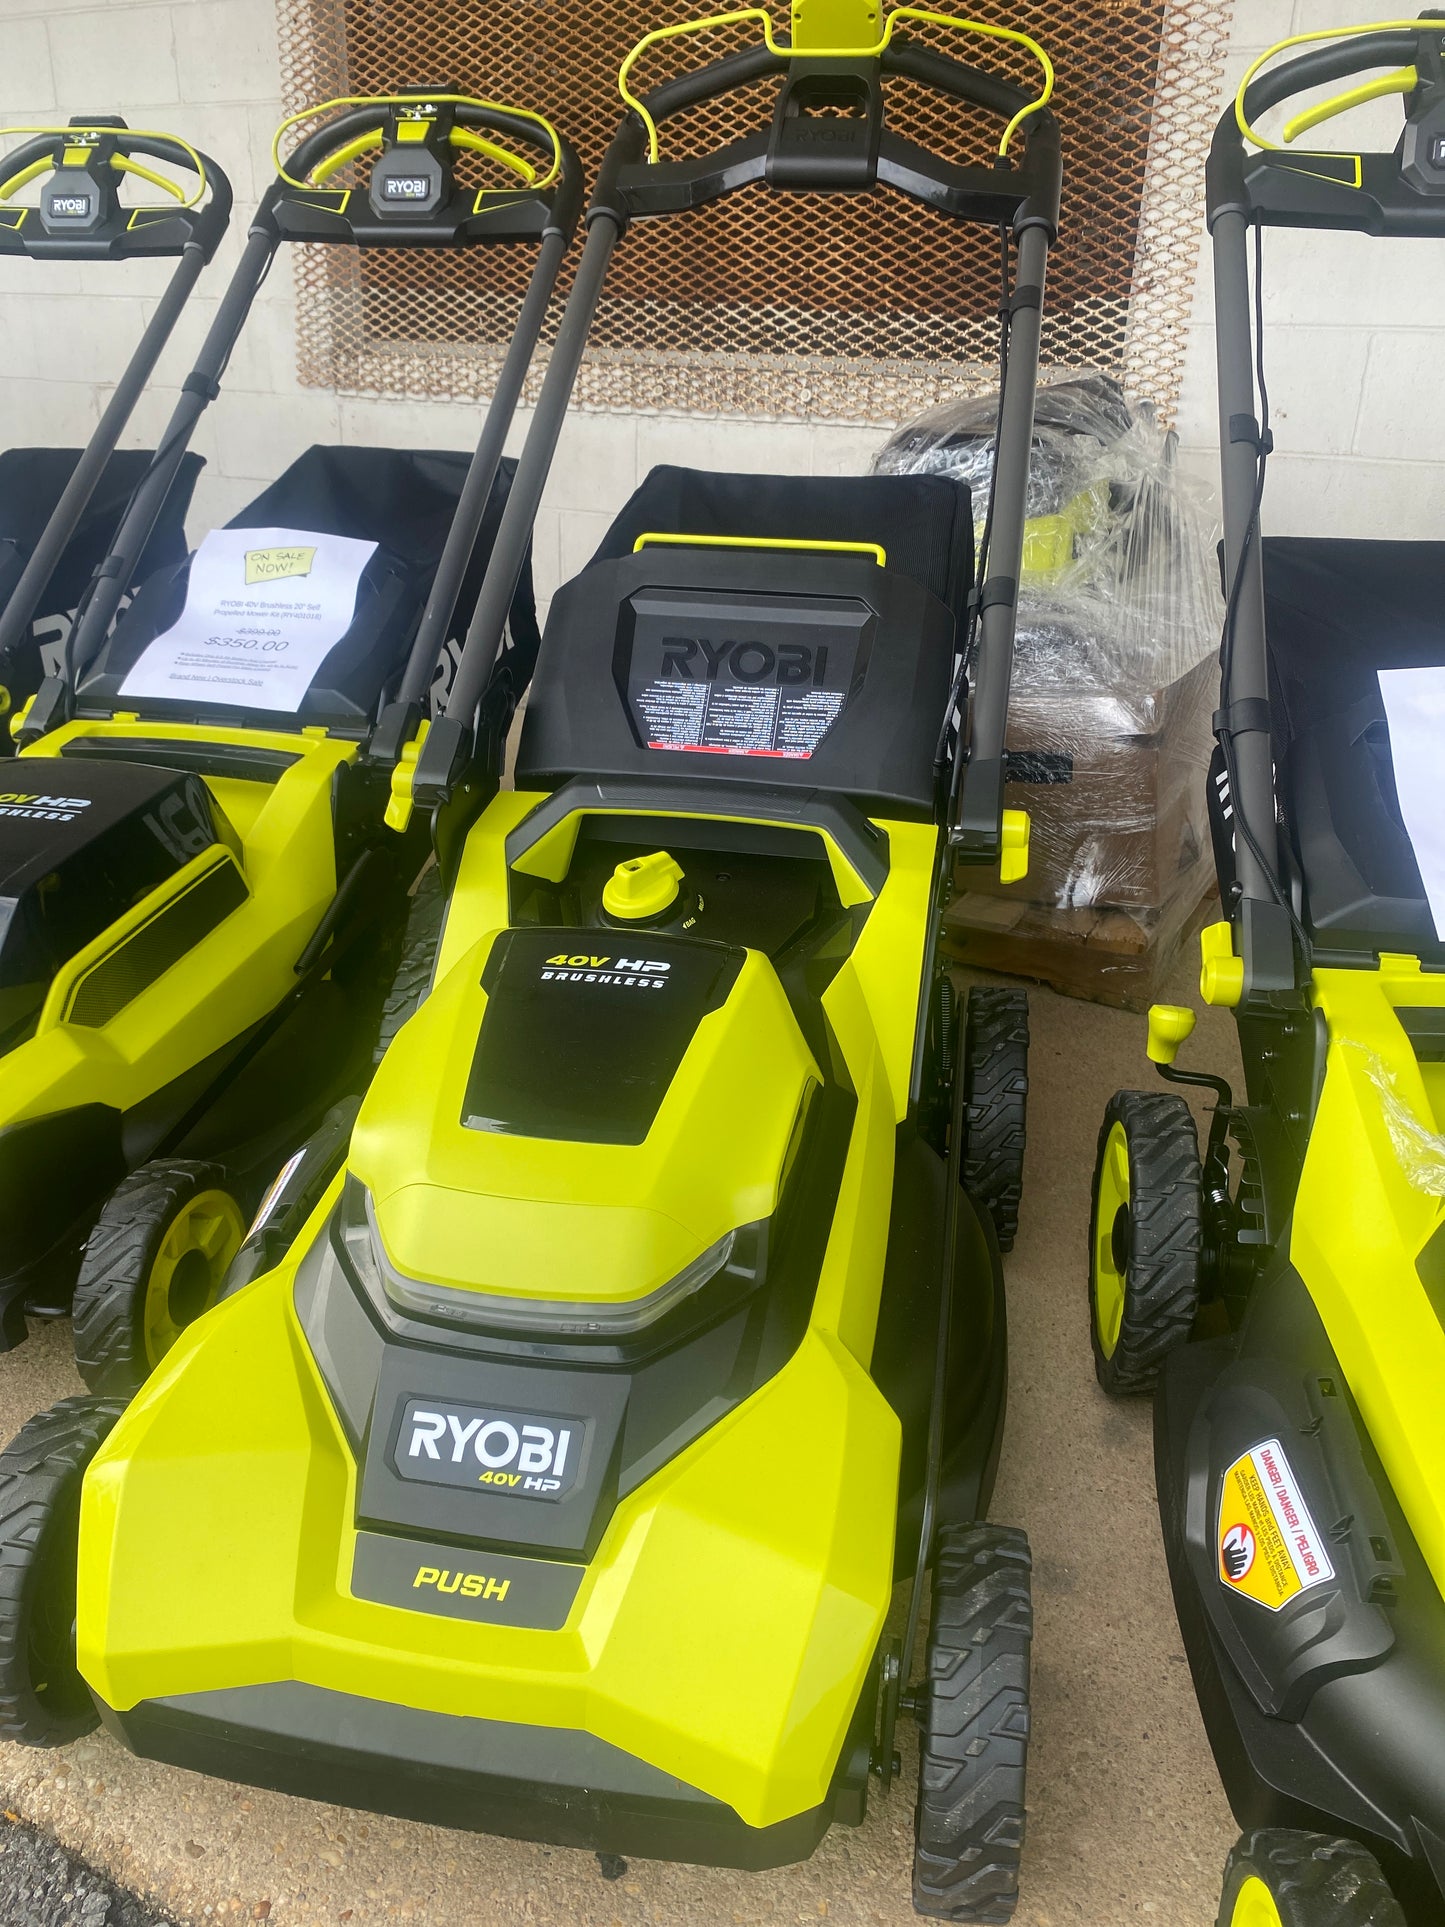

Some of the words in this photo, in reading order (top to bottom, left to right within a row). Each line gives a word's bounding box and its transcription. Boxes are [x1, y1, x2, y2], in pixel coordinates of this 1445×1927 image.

[387, 180, 426, 193] RYOBI
[53, 199, 86, 211] RYOBI
[250, 553, 270, 561] ON
[276, 552, 305, 561] SALE
[256, 562, 294, 574] NOW!
[213, 609, 246, 617] Propelled
[260, 601, 293, 610] Brushless
[204, 636, 289, 651] $350.00
[660, 637, 829, 687] RYOBI
[32, 795, 92, 808] HP
[545, 954, 611, 967] 40V
[614, 958, 672, 972] HP
[540, 971, 665, 988] BRUSHLESS
[408, 1410, 571, 1477] RYOBI
[478, 1471, 522, 1487] 40V
[523, 1476, 561, 1491] HP
[1260, 1449, 1281, 1486] DANGER
[1276, 1489, 1299, 1529] DANGER
[1295, 1534, 1319, 1577] PELIGRO
[1249, 1475, 1260, 1492] KEEP
[1255, 1493, 1269, 1516] HANDS
[1265, 1518, 1274, 1531] and
[1271, 1531, 1281, 1549] FEET
[1277, 1550, 1290, 1571] AWAY
[1274, 1559, 1288, 1587] DISTANCE
[412, 1567, 511, 1602] PUSH
